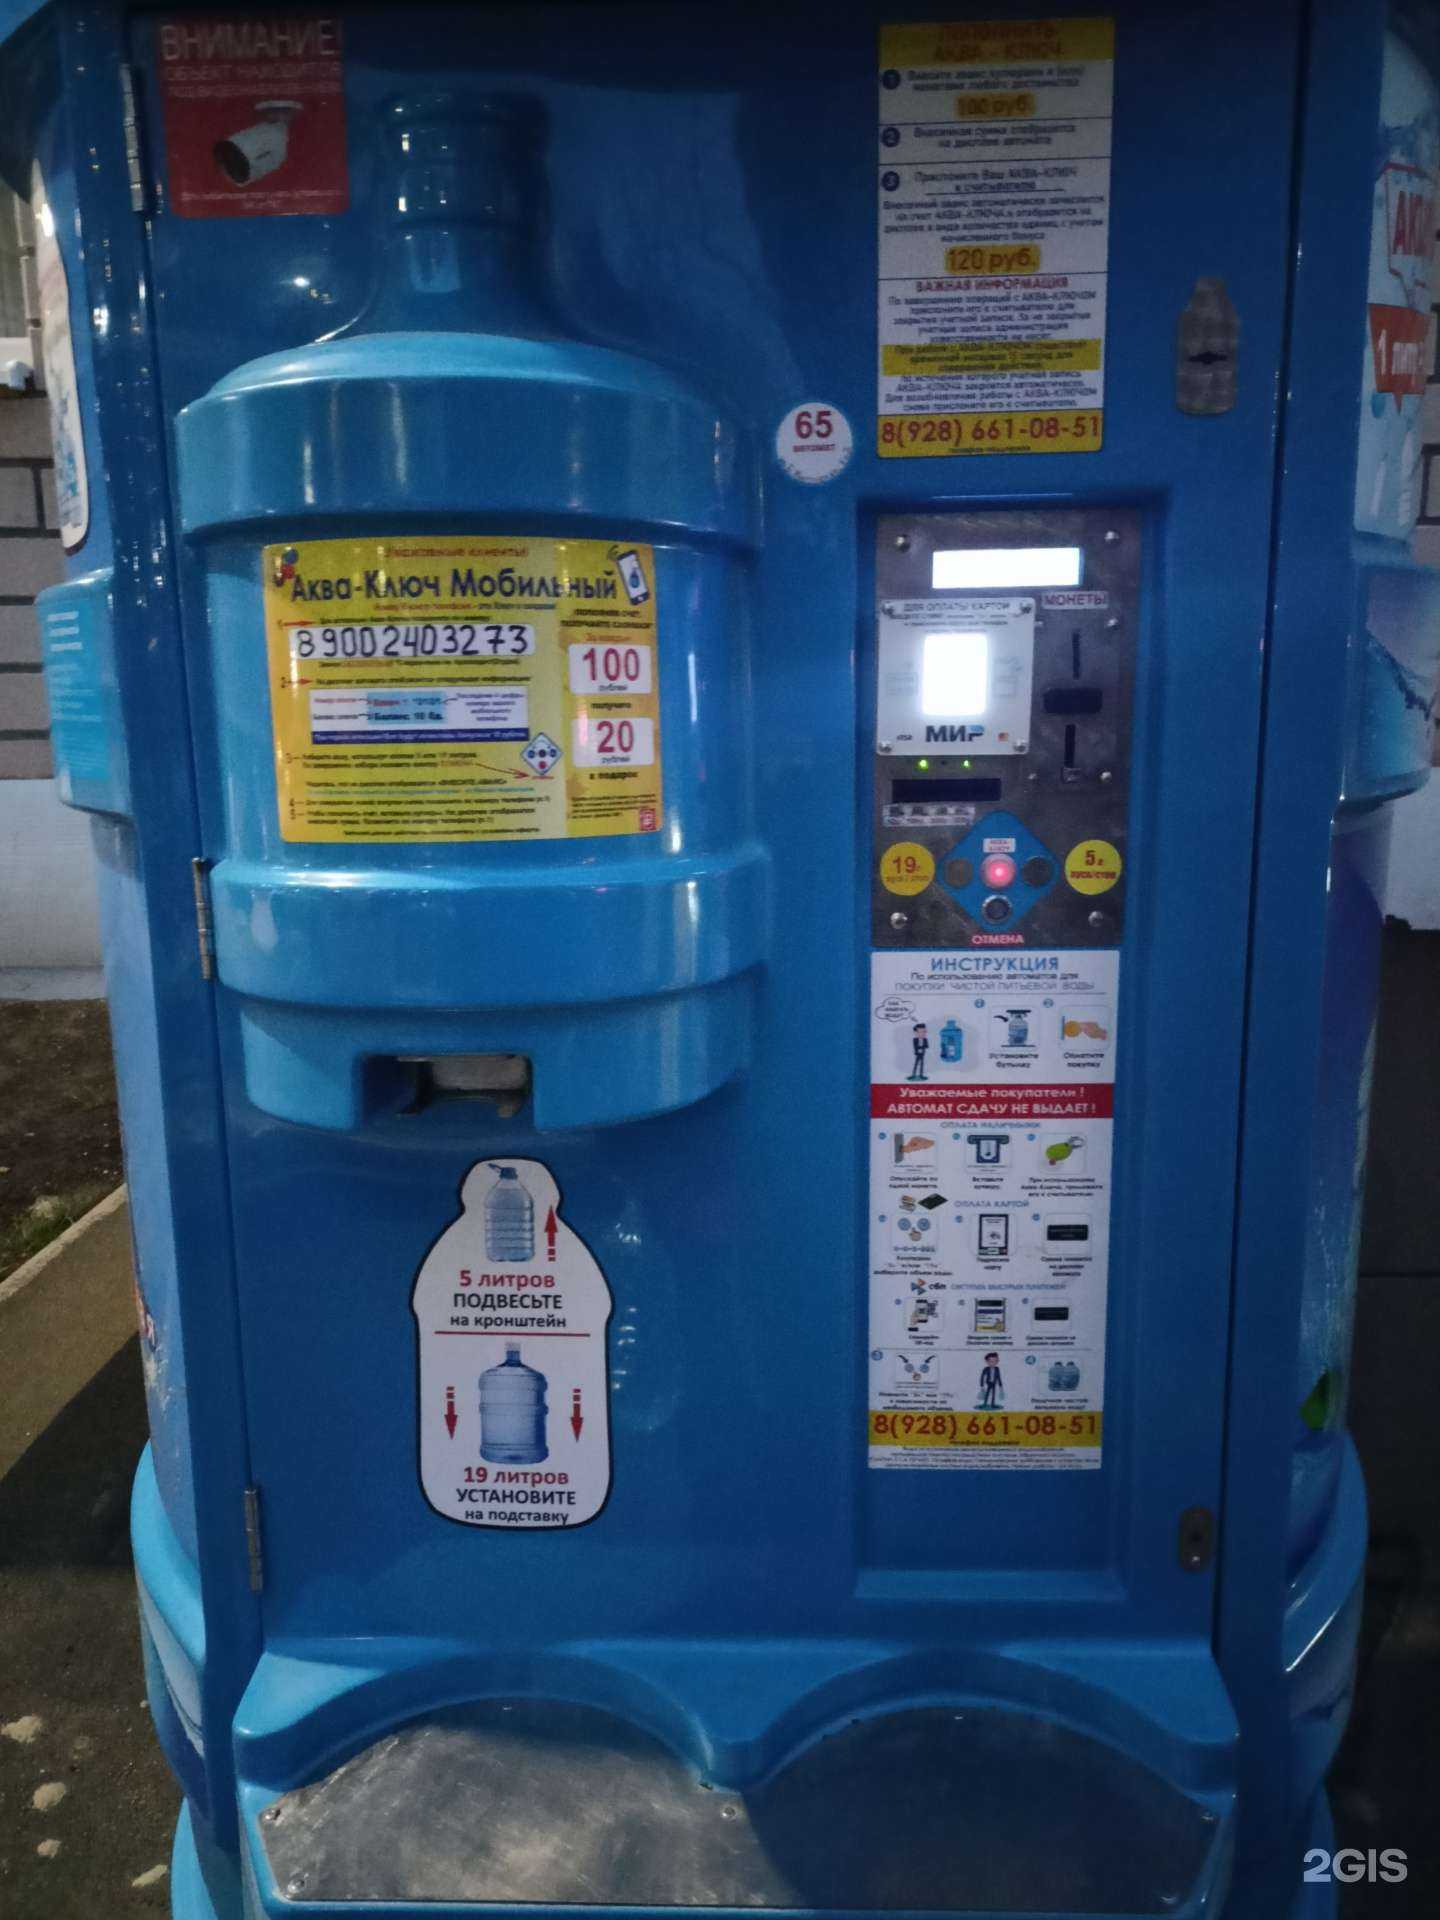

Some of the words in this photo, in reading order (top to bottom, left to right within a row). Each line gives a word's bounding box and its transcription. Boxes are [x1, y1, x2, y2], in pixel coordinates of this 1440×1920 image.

[161, 20, 336, 60] ВНИМАНИЕ
[949, 249, 983, 270] 120
[795, 411, 833, 439] 65
[881, 418, 963, 448] 8(928)
[971, 415, 1100, 441] 661-08-51
[291, 568, 441, 602] Аква-Ключ
[451, 566, 618, 600] Мобильный
[1044, 593, 1106, 605] МОНЕТЫ
[583, 648, 640, 681] 100
[596, 720, 634, 754] 20
[925, 725, 985, 742] МИР
[892, 856, 917, 873] 19
[1085, 850, 1096, 866] 5
[972, 934, 1024, 944] ОТМЕНА
[931, 957, 1059, 972] ИНСТРУКЦИЯ
[950, 980, 996, 990] ЧИСТОЙ
[997, 980, 1058, 990] ПИТЬЕВОЙ
[1062, 981, 1095, 990] ВОДЫ
[900, 1087, 987, 1098] Уважаемые
[990, 1088, 1077, 1100] покупатели
[887, 1103, 953, 1114] АВТОМАТ
[957, 1103, 1007, 1115] СДАЧУ
[1011, 1103, 1028, 1114] НЕ
[459, 1270, 472, 1287] 5
[478, 1272, 556, 1289] литров
[453, 1293, 563, 1312] ПОДВЕСЬТЕ
[450, 1316, 471, 1328] на
[474, 1312, 568, 1332] кронштейн
[873, 1414, 957, 1440] 8(928)
[966, 1415, 1097, 1437] 661-08-51
[463, 1466, 488, 1485] 19
[493, 1469, 570, 1487] литров
[456, 1488, 577, 1507] УСТАНОВИТЕ
[464, 1510, 484, 1522] на
[488, 1509, 570, 1527] подставку
